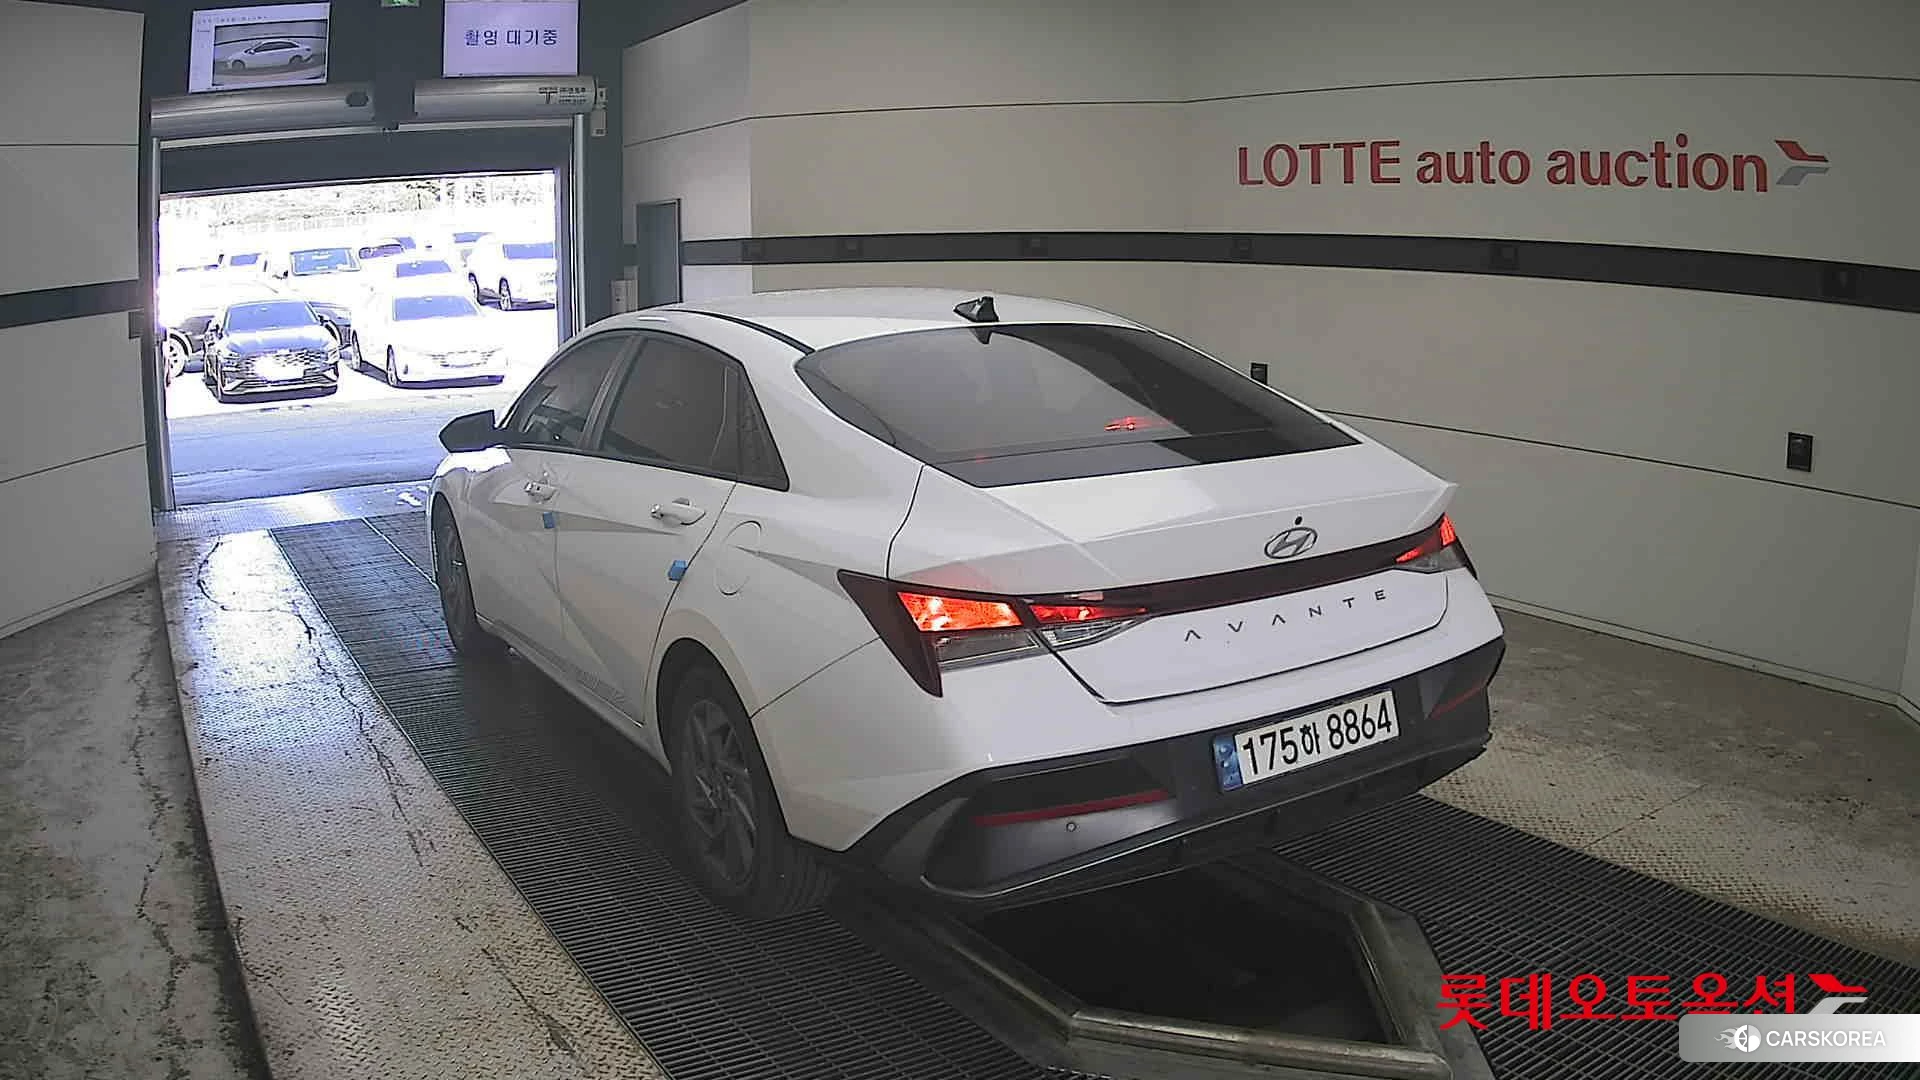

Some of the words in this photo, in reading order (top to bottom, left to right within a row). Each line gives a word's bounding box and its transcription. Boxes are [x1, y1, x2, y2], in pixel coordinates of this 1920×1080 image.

[465, 29, 498, 46] 촬영
[506, 29, 558, 46] 대기중
[1238, 140, 1401, 187] LOTTE
[1416, 140, 1531, 184] auto
[1546, 133, 1768, 193] auction
[1184, 589, 1387, 642] AVANTE
[1326, 698, 1392, 750] 8864
